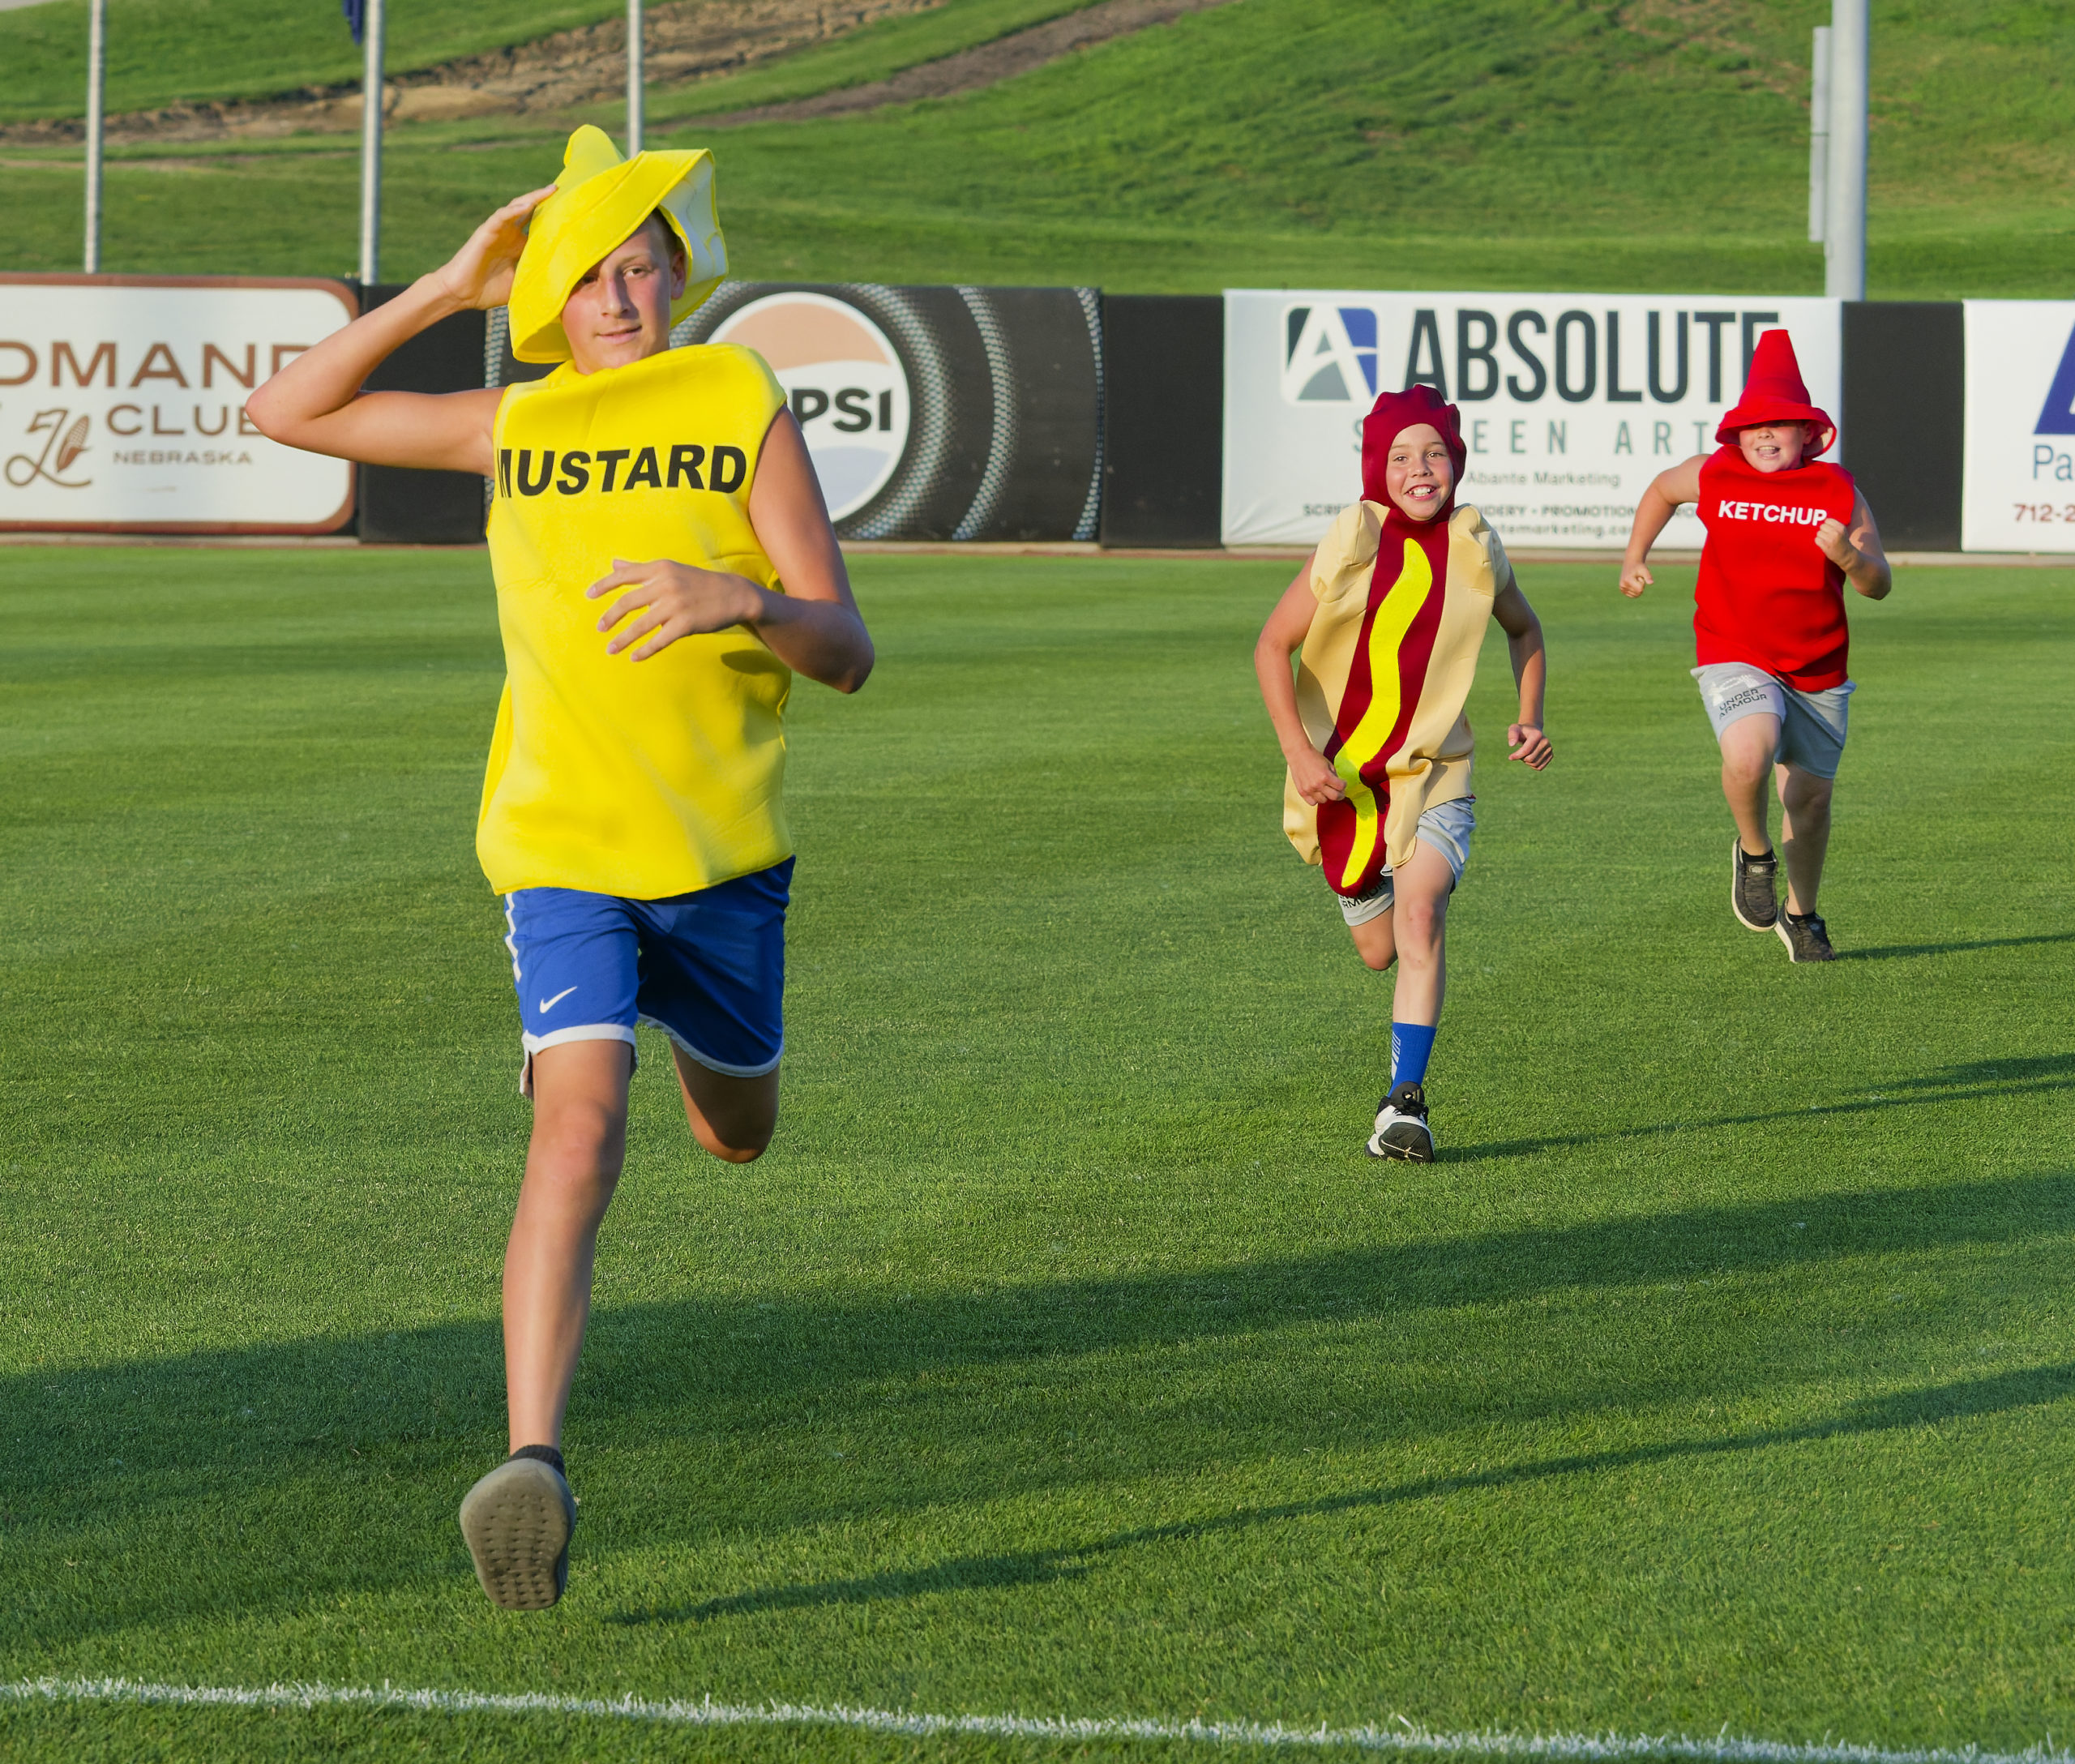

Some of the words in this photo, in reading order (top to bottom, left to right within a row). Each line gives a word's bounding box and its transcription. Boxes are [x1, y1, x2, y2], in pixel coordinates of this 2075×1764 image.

[113, 449, 252, 465] NEBRASKA
[497, 444, 747, 499] MUSTARD
[1466, 472, 1527, 485] Abante
[1534, 472, 1621, 488] Marketing
[1303, 503, 1350, 517] SCRE
[1718, 500, 1827, 526] KETCHUP
[1719, 688, 1759, 710] UNDER
[1719, 694, 1767, 720] ARMOUR
